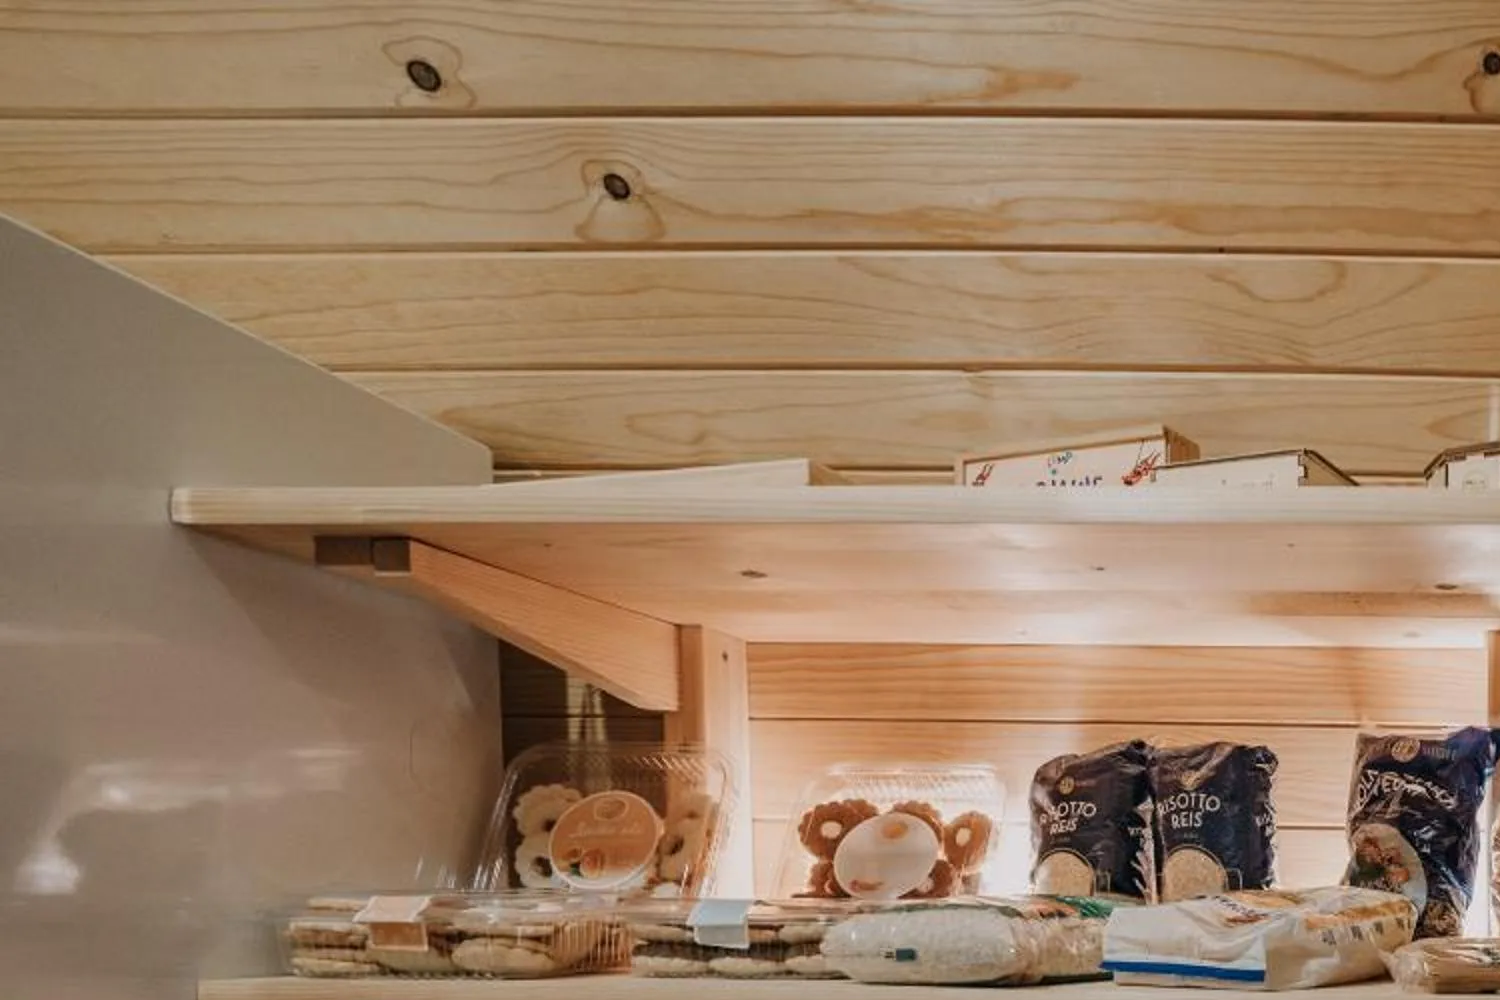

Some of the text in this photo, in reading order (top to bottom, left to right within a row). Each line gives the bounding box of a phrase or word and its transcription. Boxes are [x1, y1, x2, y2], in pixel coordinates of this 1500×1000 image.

[1157, 791, 1221, 816] RISOTTO
[1050, 817, 1078, 834] REIS
[1171, 811, 1204, 829] REIS
